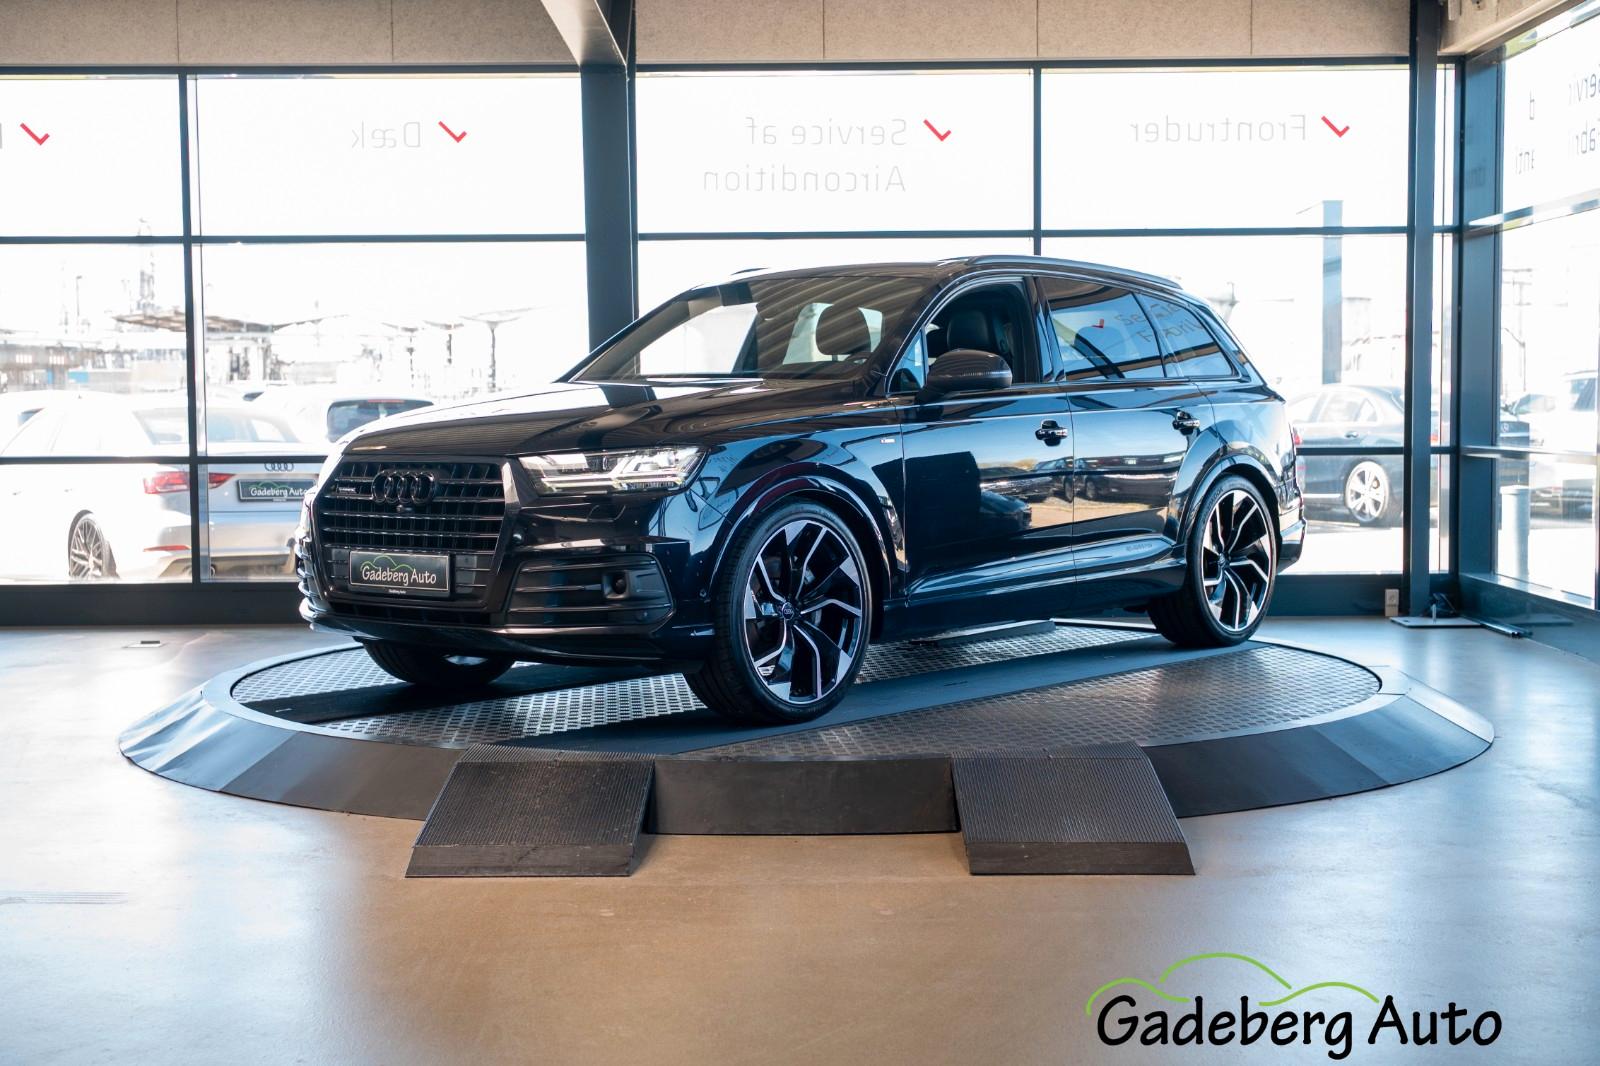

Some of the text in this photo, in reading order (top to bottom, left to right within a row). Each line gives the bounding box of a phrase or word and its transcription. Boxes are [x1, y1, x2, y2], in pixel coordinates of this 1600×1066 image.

[250, 487, 288, 499] Gadeberg
[362, 565, 437, 586] Gadeberg Auto
